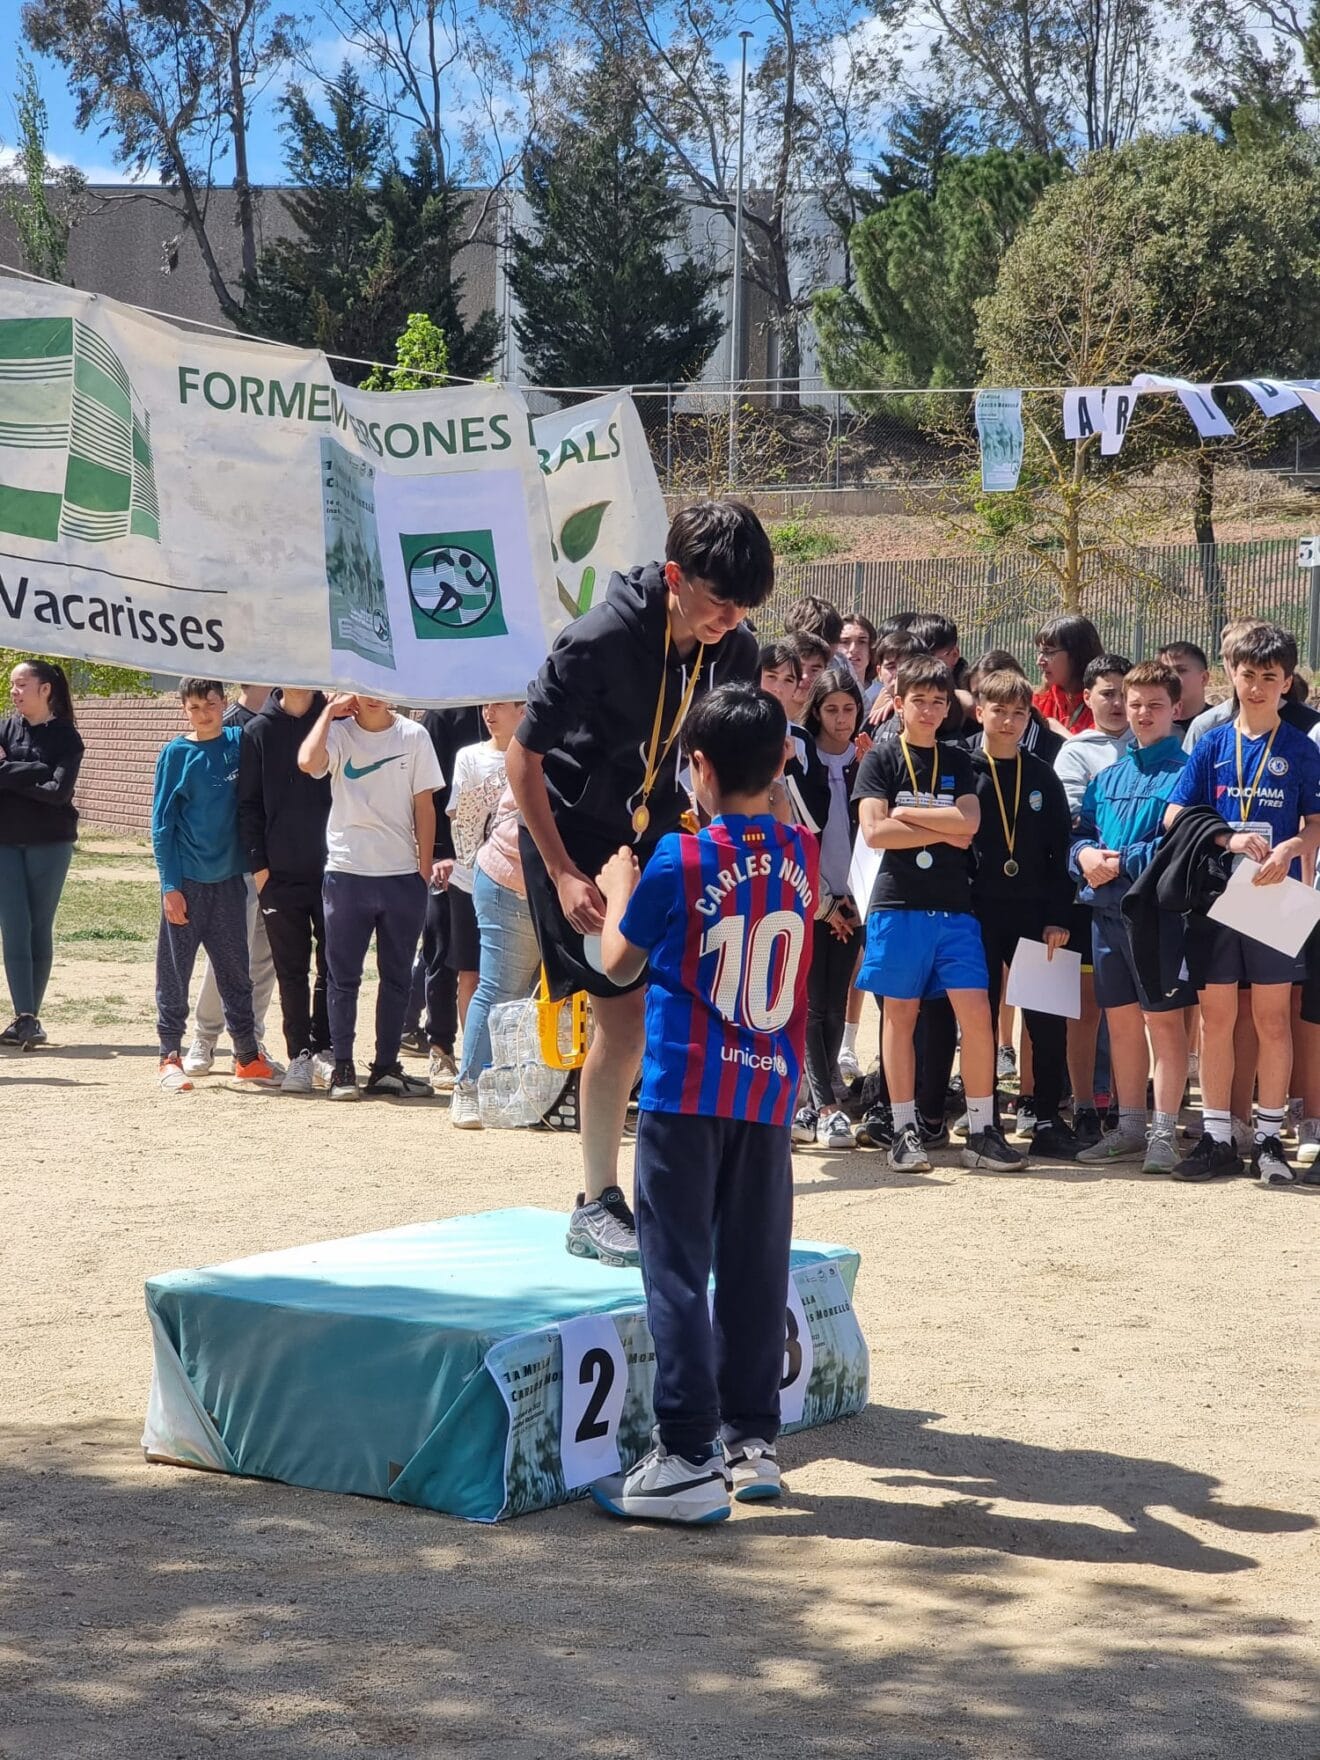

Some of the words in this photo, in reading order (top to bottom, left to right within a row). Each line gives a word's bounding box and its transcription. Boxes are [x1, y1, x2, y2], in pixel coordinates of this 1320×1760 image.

[537, 422, 620, 476] RALS
[0, 577, 225, 653] Vacarisses
[1259, 799, 1284, 808] TYRES
[695, 853, 772, 916] CARLES
[699, 910, 805, 1033] 10
[629, 1352, 655, 1365] MOR
[575, 1348, 615, 1443] 2
